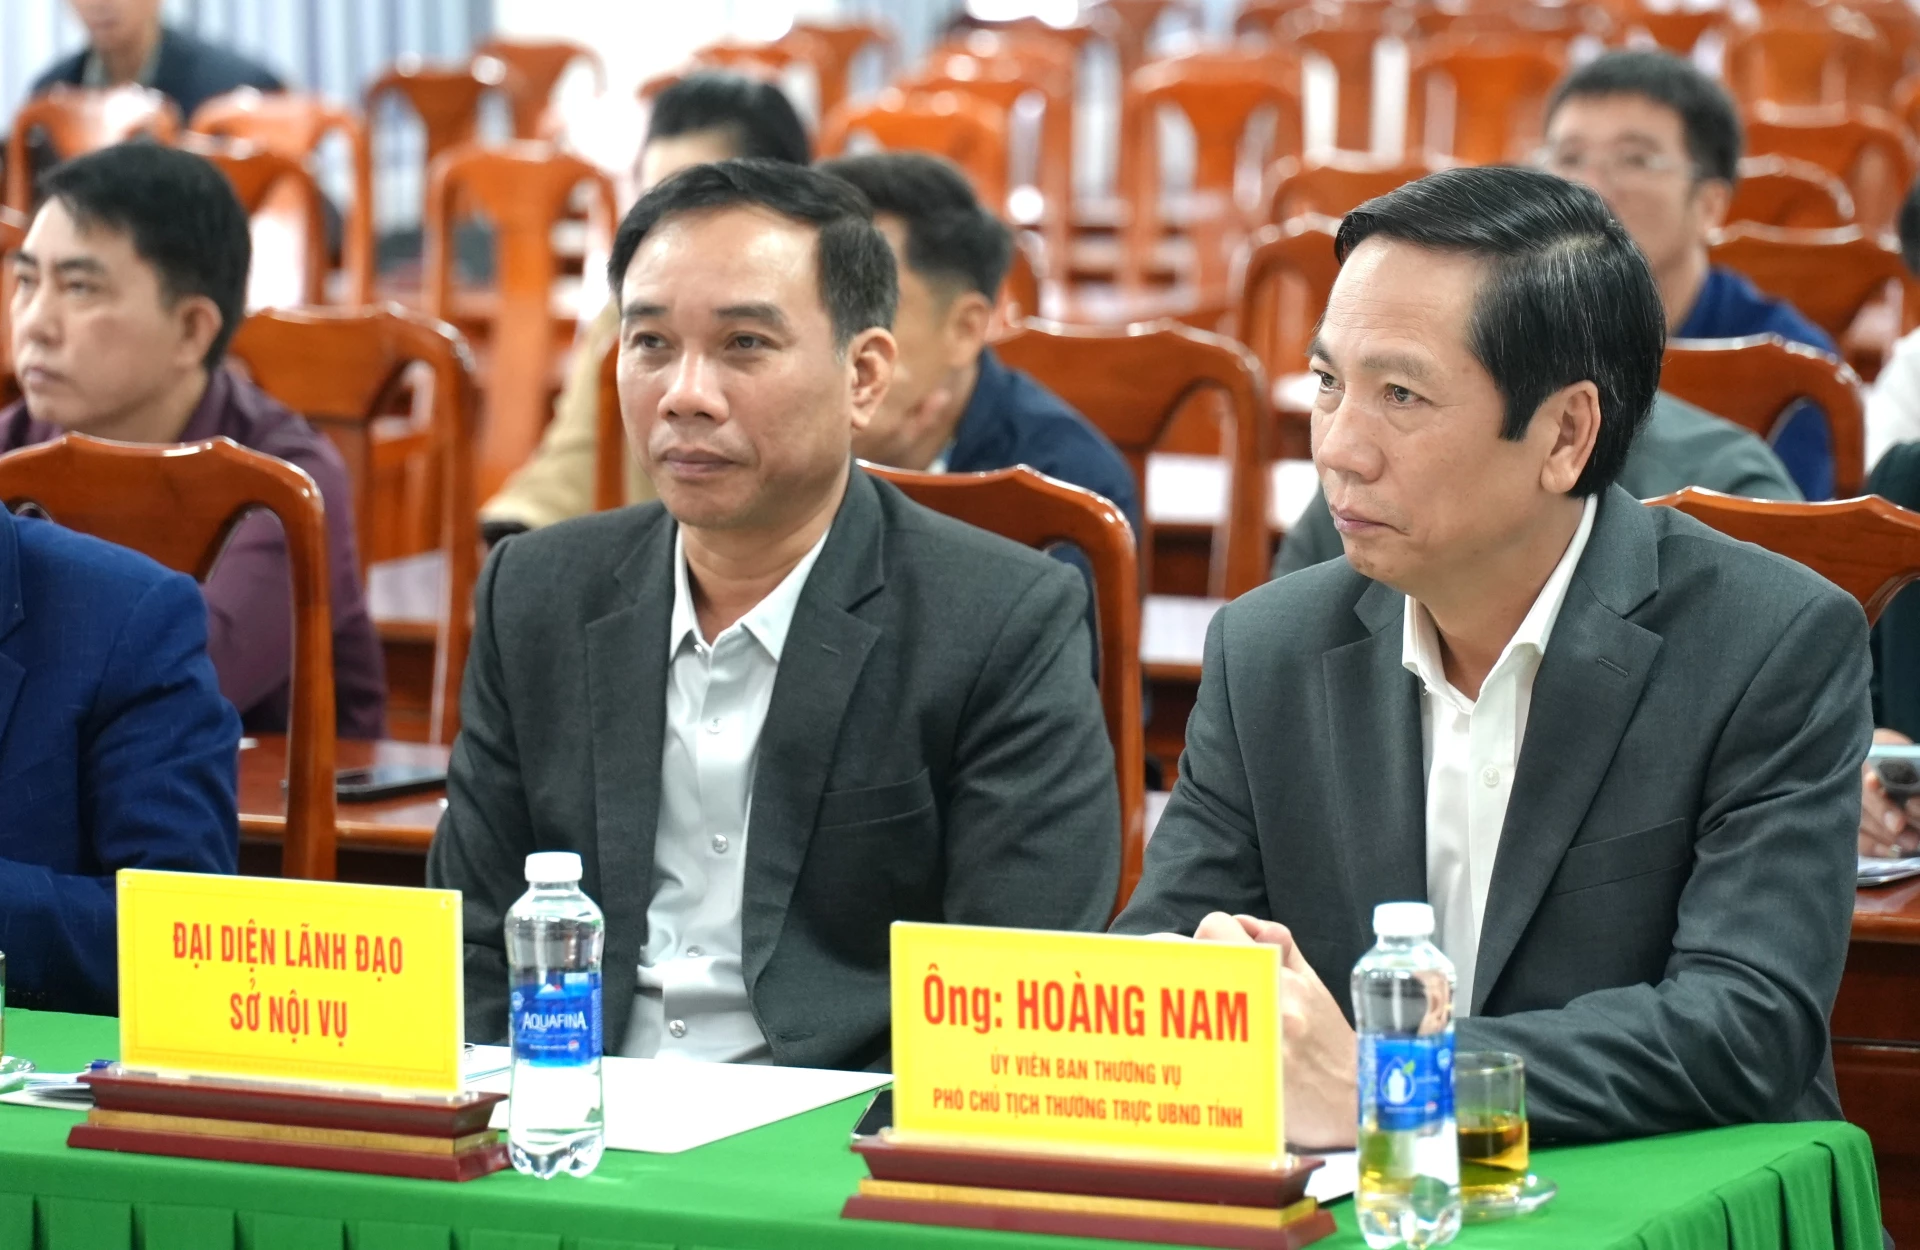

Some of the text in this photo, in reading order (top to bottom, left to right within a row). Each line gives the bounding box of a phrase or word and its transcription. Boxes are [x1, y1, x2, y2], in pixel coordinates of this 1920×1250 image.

[172, 918, 404, 982] ĐẠI DIỆN LÃNH ĐẠO
[229, 977, 348, 1048] SỞ NỘI VỤ
[522, 1011, 588, 1033] AQUAFINA
[923, 963, 1249, 1043] Ông: HOÀNG NAM
[1015, 1052, 1051, 1078] VIÊN
[1056, 1058, 1088, 1080] BAN
[1094, 1057, 1156, 1085] THƯỜNG
[1162, 1064, 1182, 1091] VỤ
[933, 1085, 964, 1111] PHÓ
[1005, 1091, 1040, 1119] TỊCH
[1045, 1092, 1107, 1120] THƯỜNG
[1112, 1098, 1152, 1127] TRỰC
[1158, 1102, 1201, 1126] UBND
